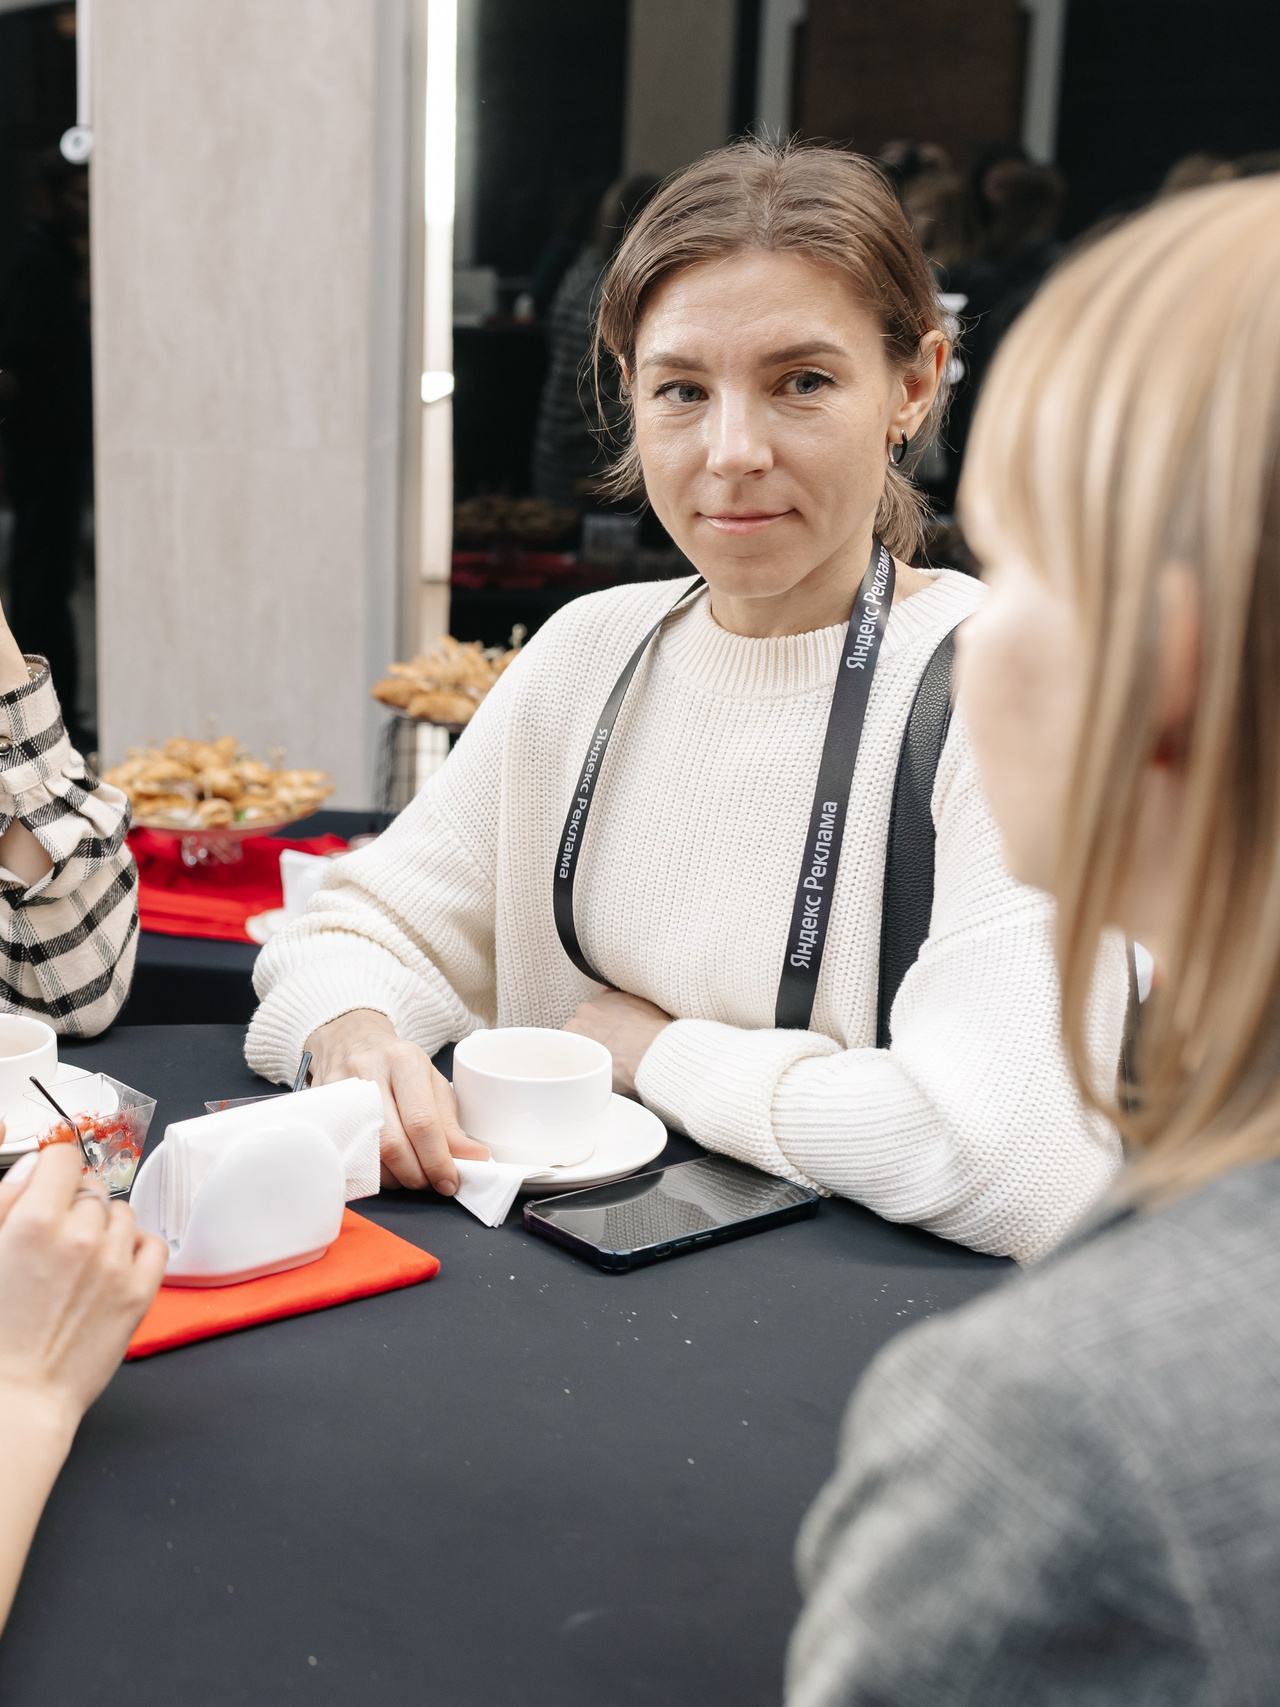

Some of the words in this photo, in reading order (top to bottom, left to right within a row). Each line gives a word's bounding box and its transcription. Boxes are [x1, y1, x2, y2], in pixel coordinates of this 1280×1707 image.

[846, 606, 880, 670] Яндекс
[863, 545, 891, 606] Реклама
[580, 728, 608, 793] Яндекс
[559, 797, 588, 879] Реклама
[803, 801, 838, 890] Реклама
[789, 895, 821, 969] Яндекс
